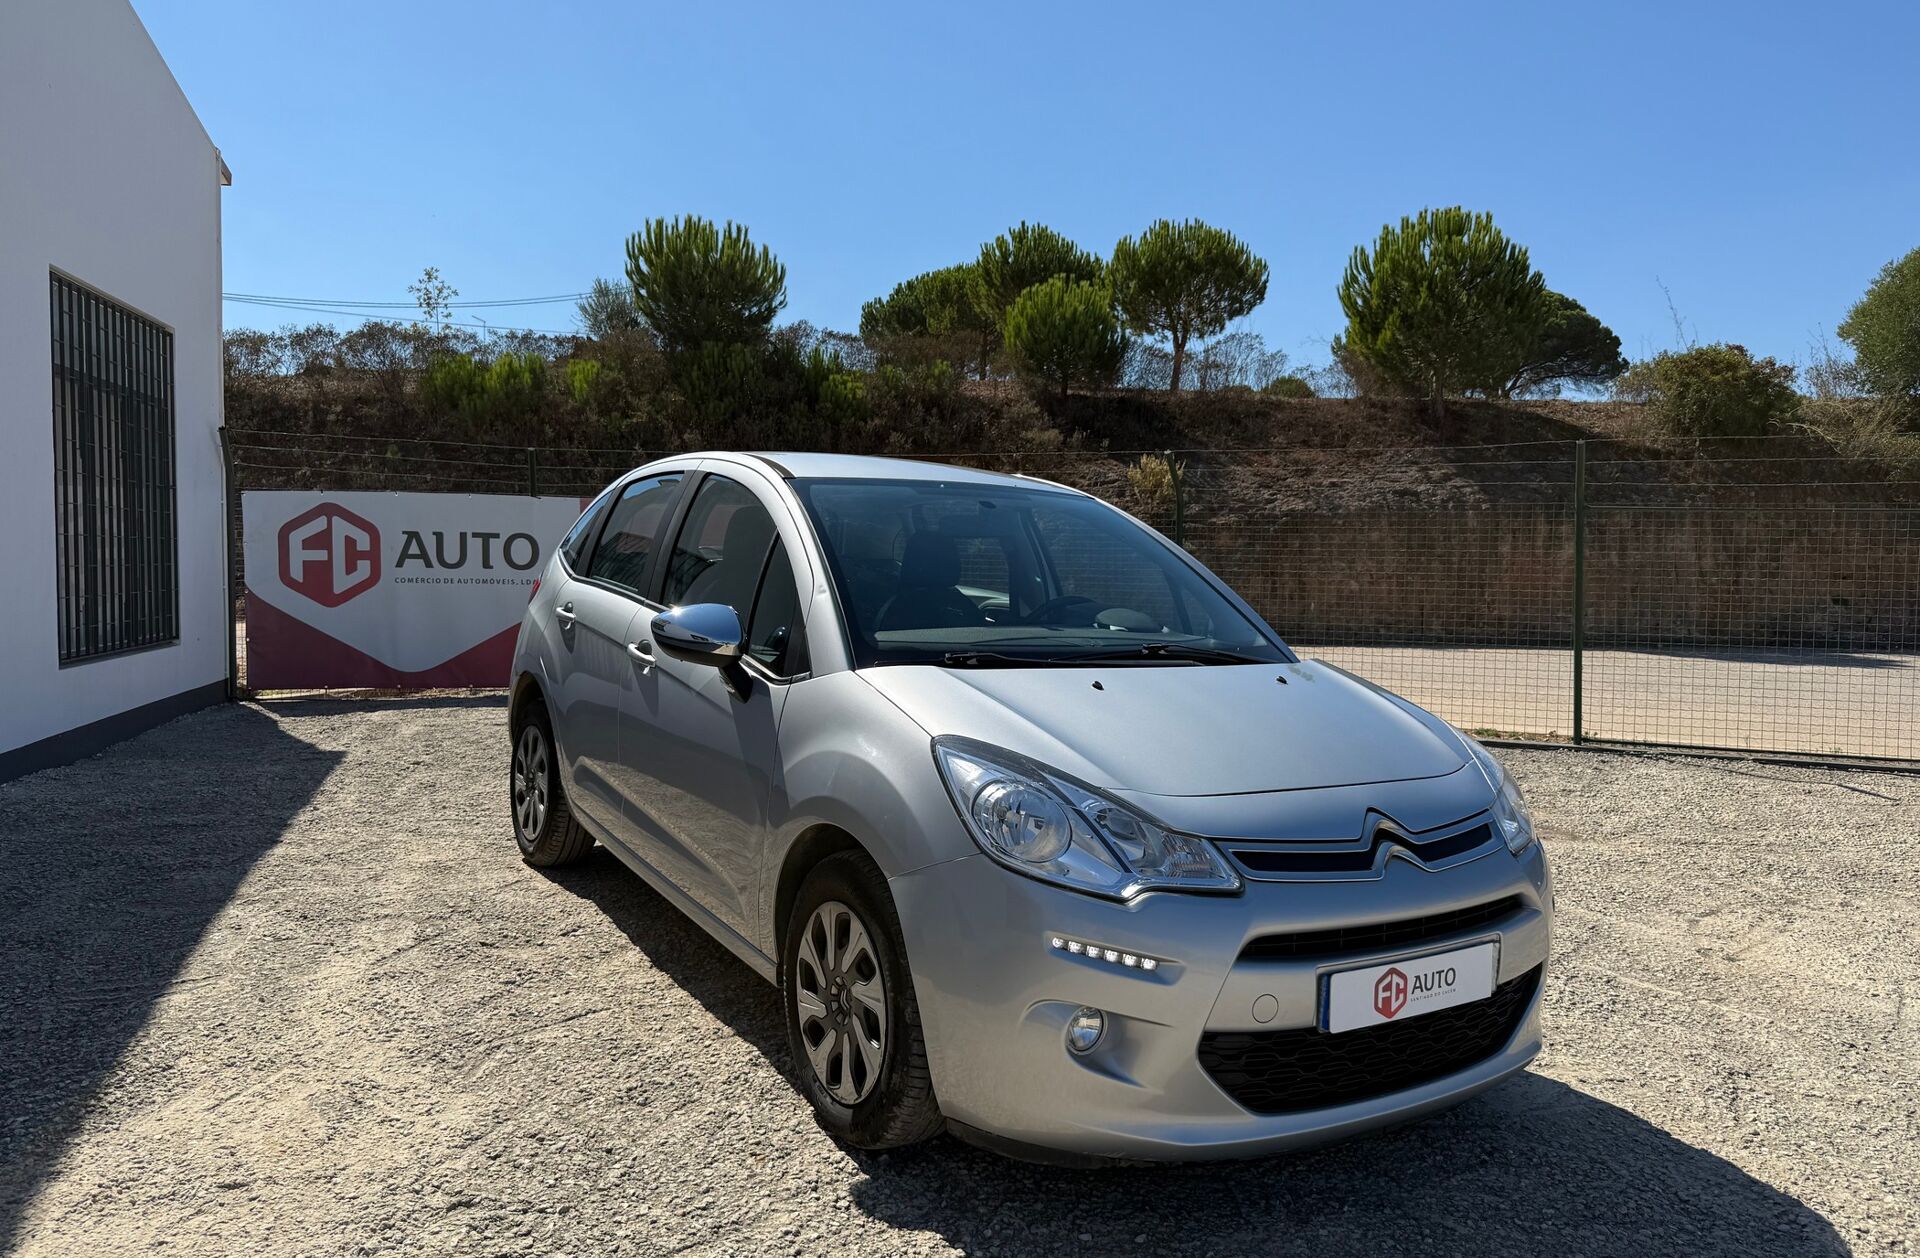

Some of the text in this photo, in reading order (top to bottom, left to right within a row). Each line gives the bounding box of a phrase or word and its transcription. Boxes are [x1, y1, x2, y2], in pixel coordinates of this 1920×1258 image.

[395, 530, 540, 571] AUTO
[394, 576, 441, 585] COMÉRCIO
[443, 577, 454, 585] DE
[1411, 967, 1456, 995] AUTO
